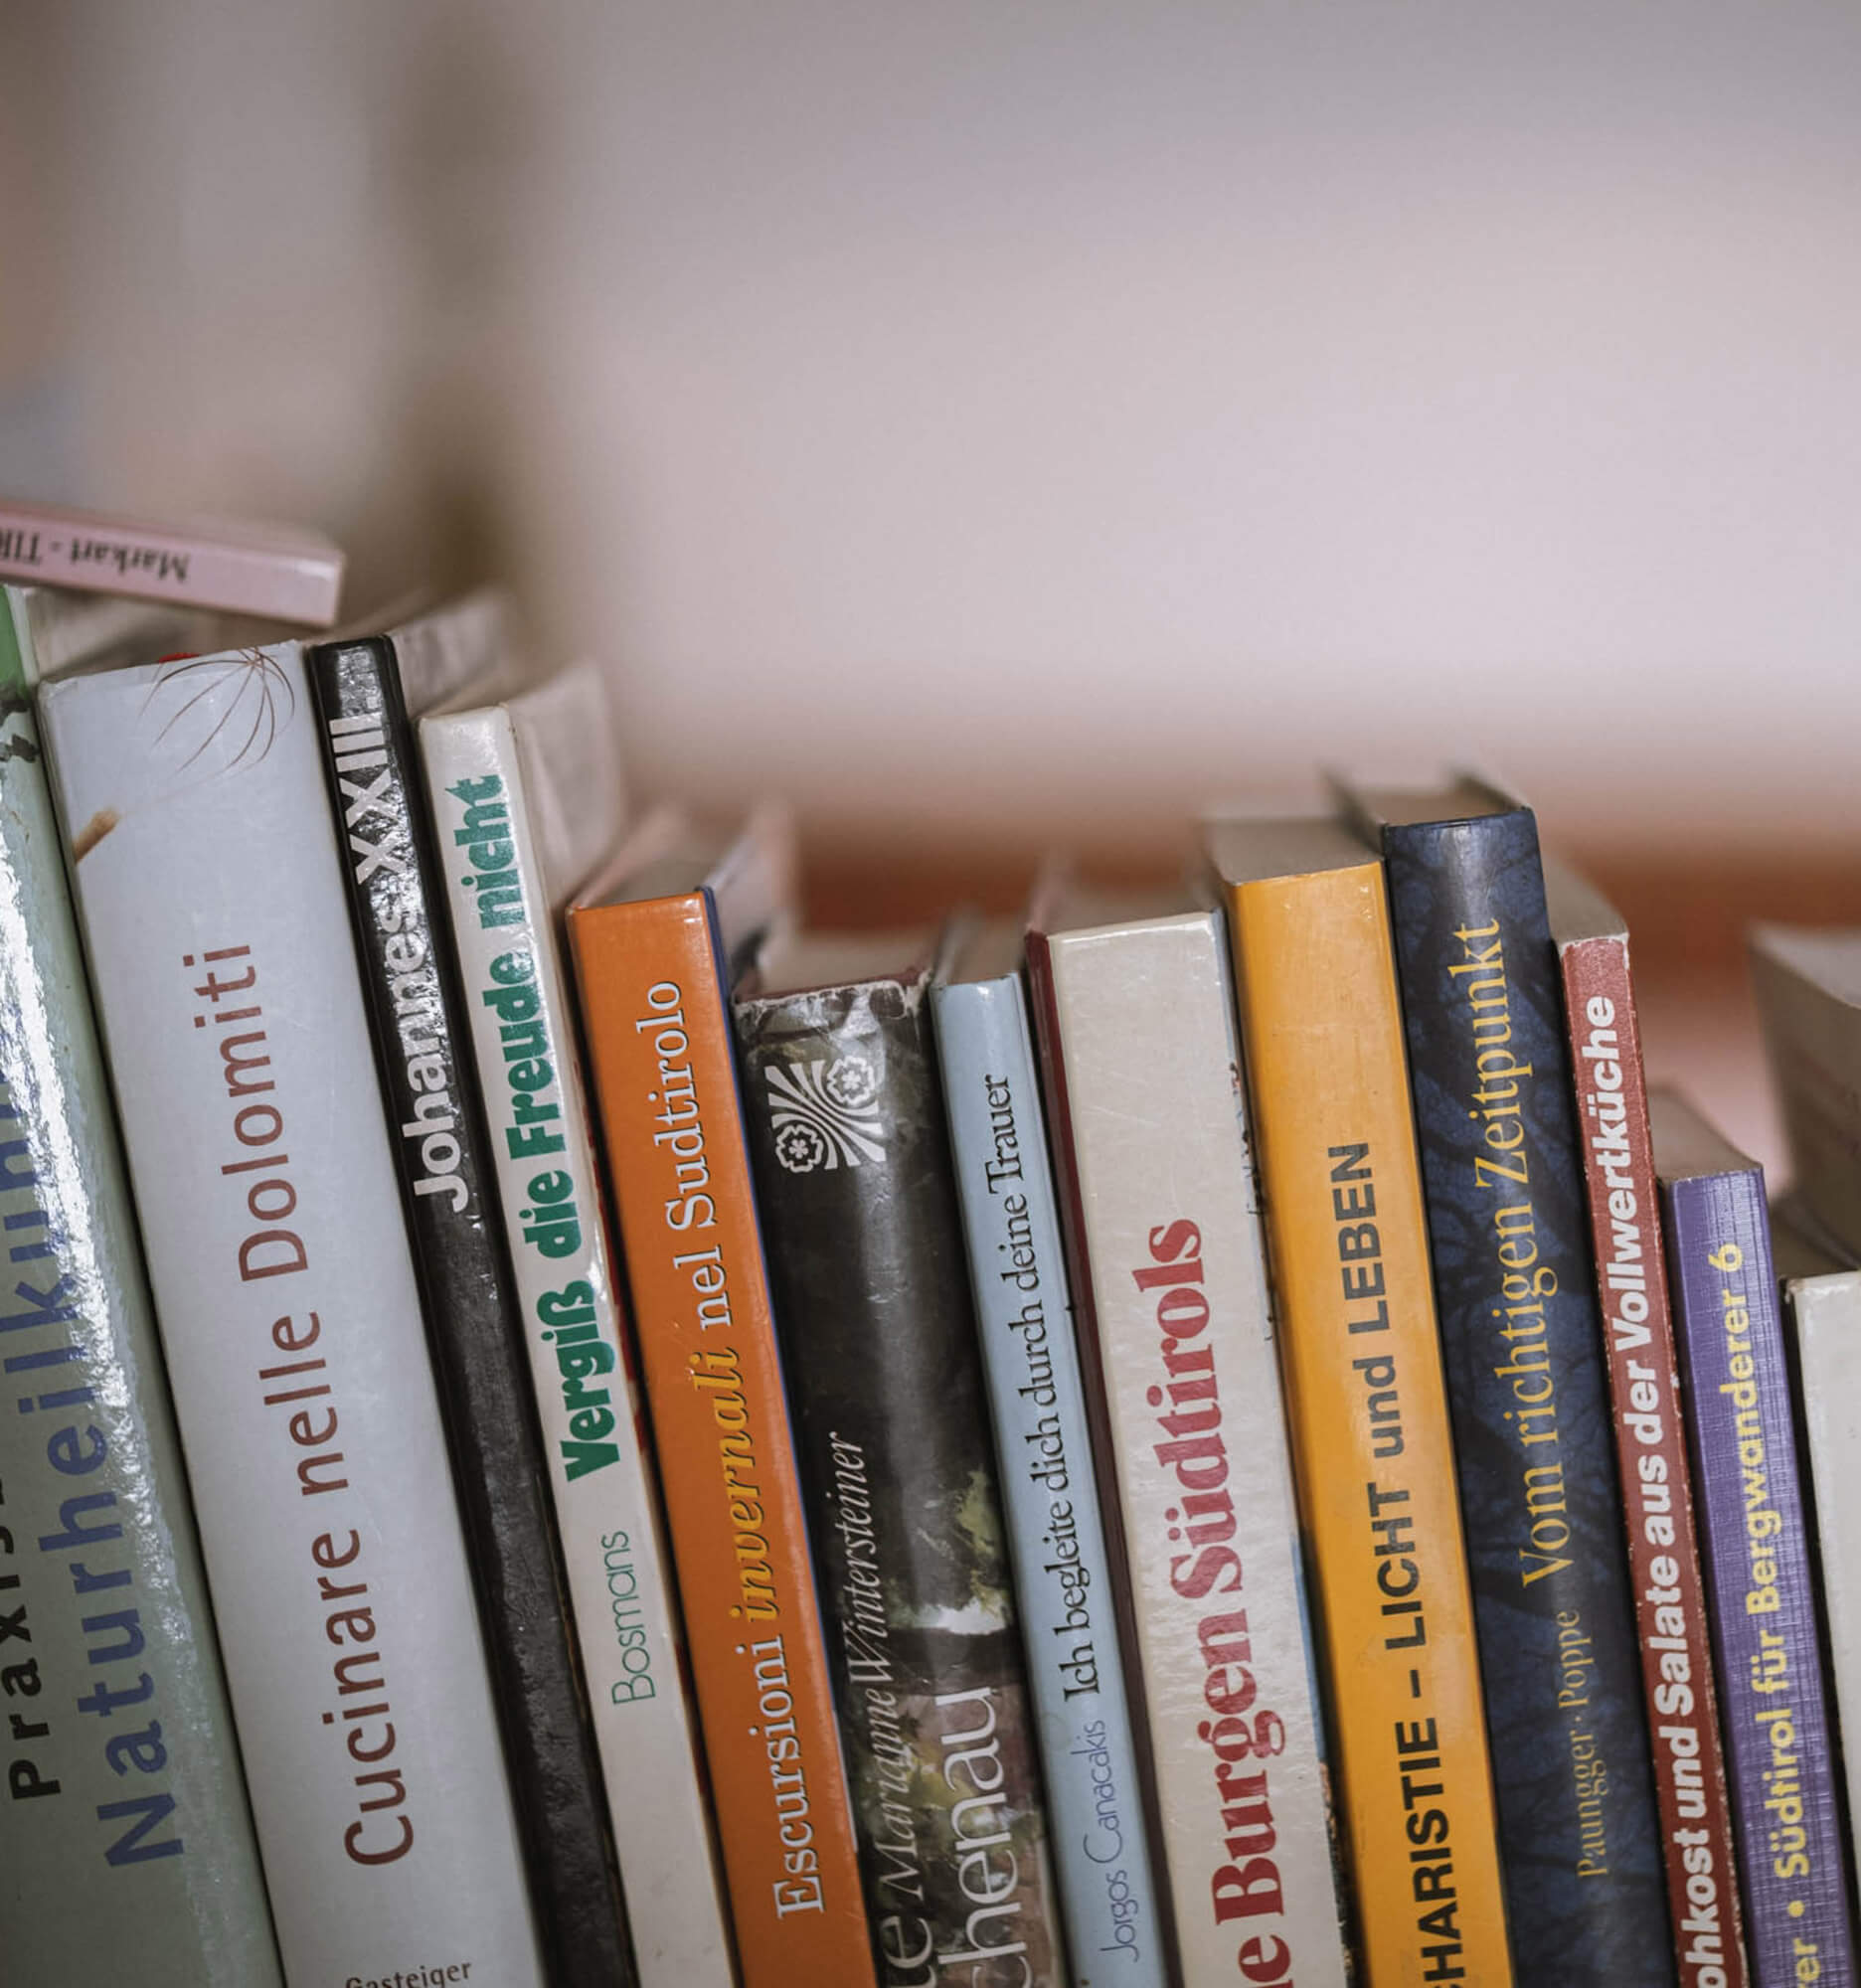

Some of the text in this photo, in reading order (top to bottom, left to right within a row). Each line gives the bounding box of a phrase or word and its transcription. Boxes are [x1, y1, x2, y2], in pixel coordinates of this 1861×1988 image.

[71, 538, 190, 581] Markart
[371, 892, 469, 1214] Johannes
[444, 773, 621, 1481] Vergiß die Freude nicht
[1328, 1142, 1391, 1335] LEBEN
[1447, 917, 1575, 1587] Vom richtigen Zeitpunkt
[1581, 995, 1649, 1352] Vollwertküche
[1708, 1242, 1744, 1273] 6
[183, 944, 414, 1866] Cucinare nelle Dolomiti
[636, 981, 824, 1918] Escursioni invernali nel Sudtirolo
[986, 1075, 1100, 1701] Ich begleite dich durch deine Trauer
[1132, 1219, 1245, 1599] Südtirols
[1353, 1355, 1405, 1458] und
[1622, 1360, 1664, 1444] der
[1719, 1288, 1782, 1614] Bergwanderer
[1367, 1481, 1427, 1650] LICHT
[1635, 1453, 1675, 1547] aus
[601, 1530, 656, 1705] Bosmans
[827, 1431, 925, 1902] Marianne Wintersteiner
[1557, 1610, 1592, 1711] Poppe
[1648, 1554, 1693, 1717] Salate
[1752, 1628, 1790, 1695] für
[1068, 1721, 1140, 1963] Jorgos Canacakis
[1196, 1608, 1285, 1925] Burgen
[1395, 1717, 1465, 1988] HARISTIE
[1567, 1729, 1610, 1880] Paungger
[1657, 1726, 1706, 1819] und
[1755, 1708, 1810, 1880] Südtirol
